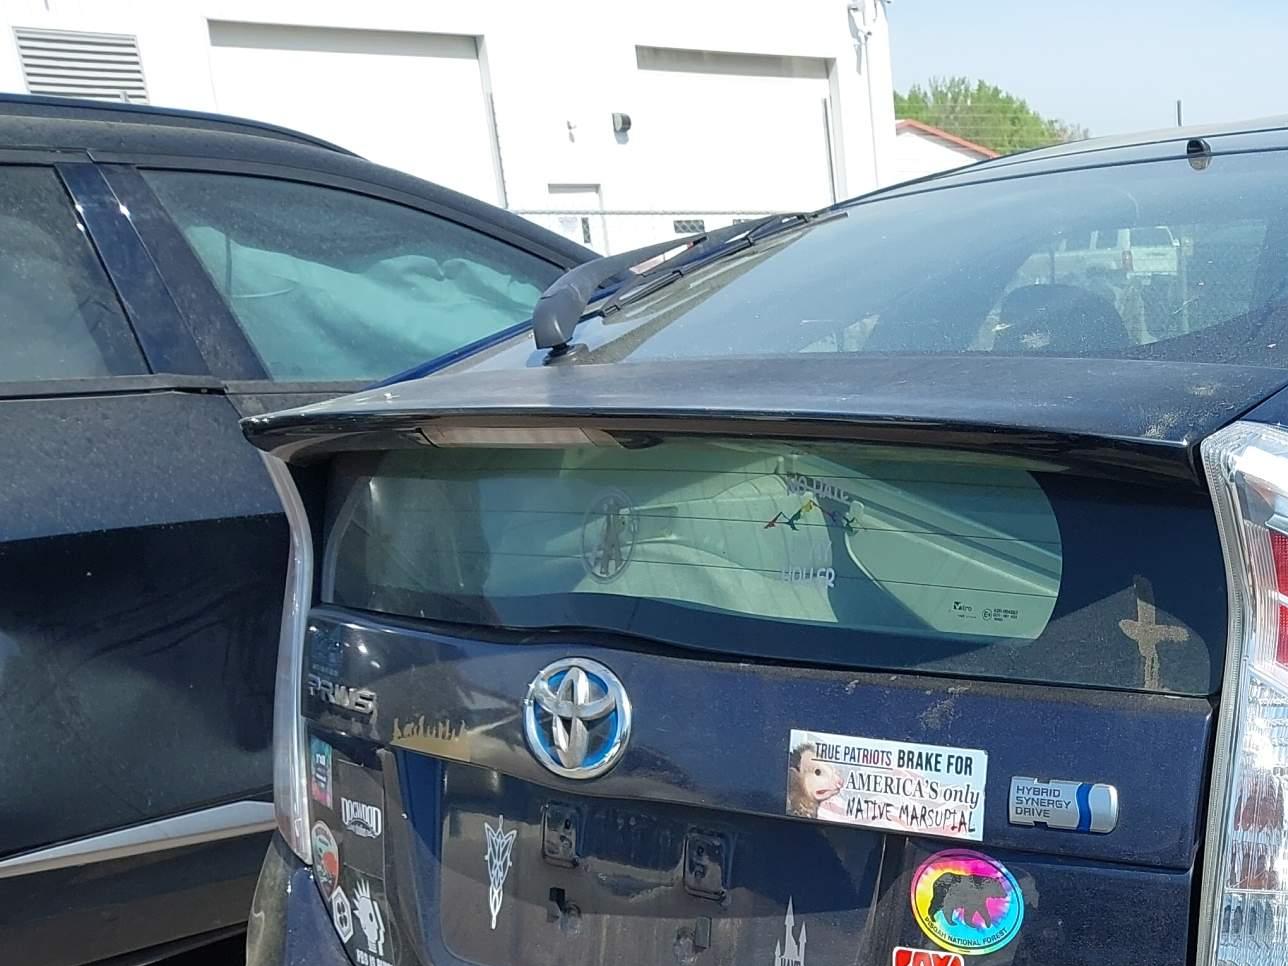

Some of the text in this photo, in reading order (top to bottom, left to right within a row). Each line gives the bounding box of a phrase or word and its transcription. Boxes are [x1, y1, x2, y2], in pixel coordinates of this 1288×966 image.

[815, 742, 973, 776] TRUE PATRIOTS BRAKE FOR
[845, 771, 980, 809] AMERICA'S only
[1016, 785, 1061, 798] HYBRID
[1015, 796, 1071, 809] SYNERGY
[846, 797, 977, 833] NATIVE MARSUPIAL
[1015, 807, 1051, 818] DRIVE
[948, 935, 981, 946] NATIONAL
[983, 928, 1008, 944] FOREST
